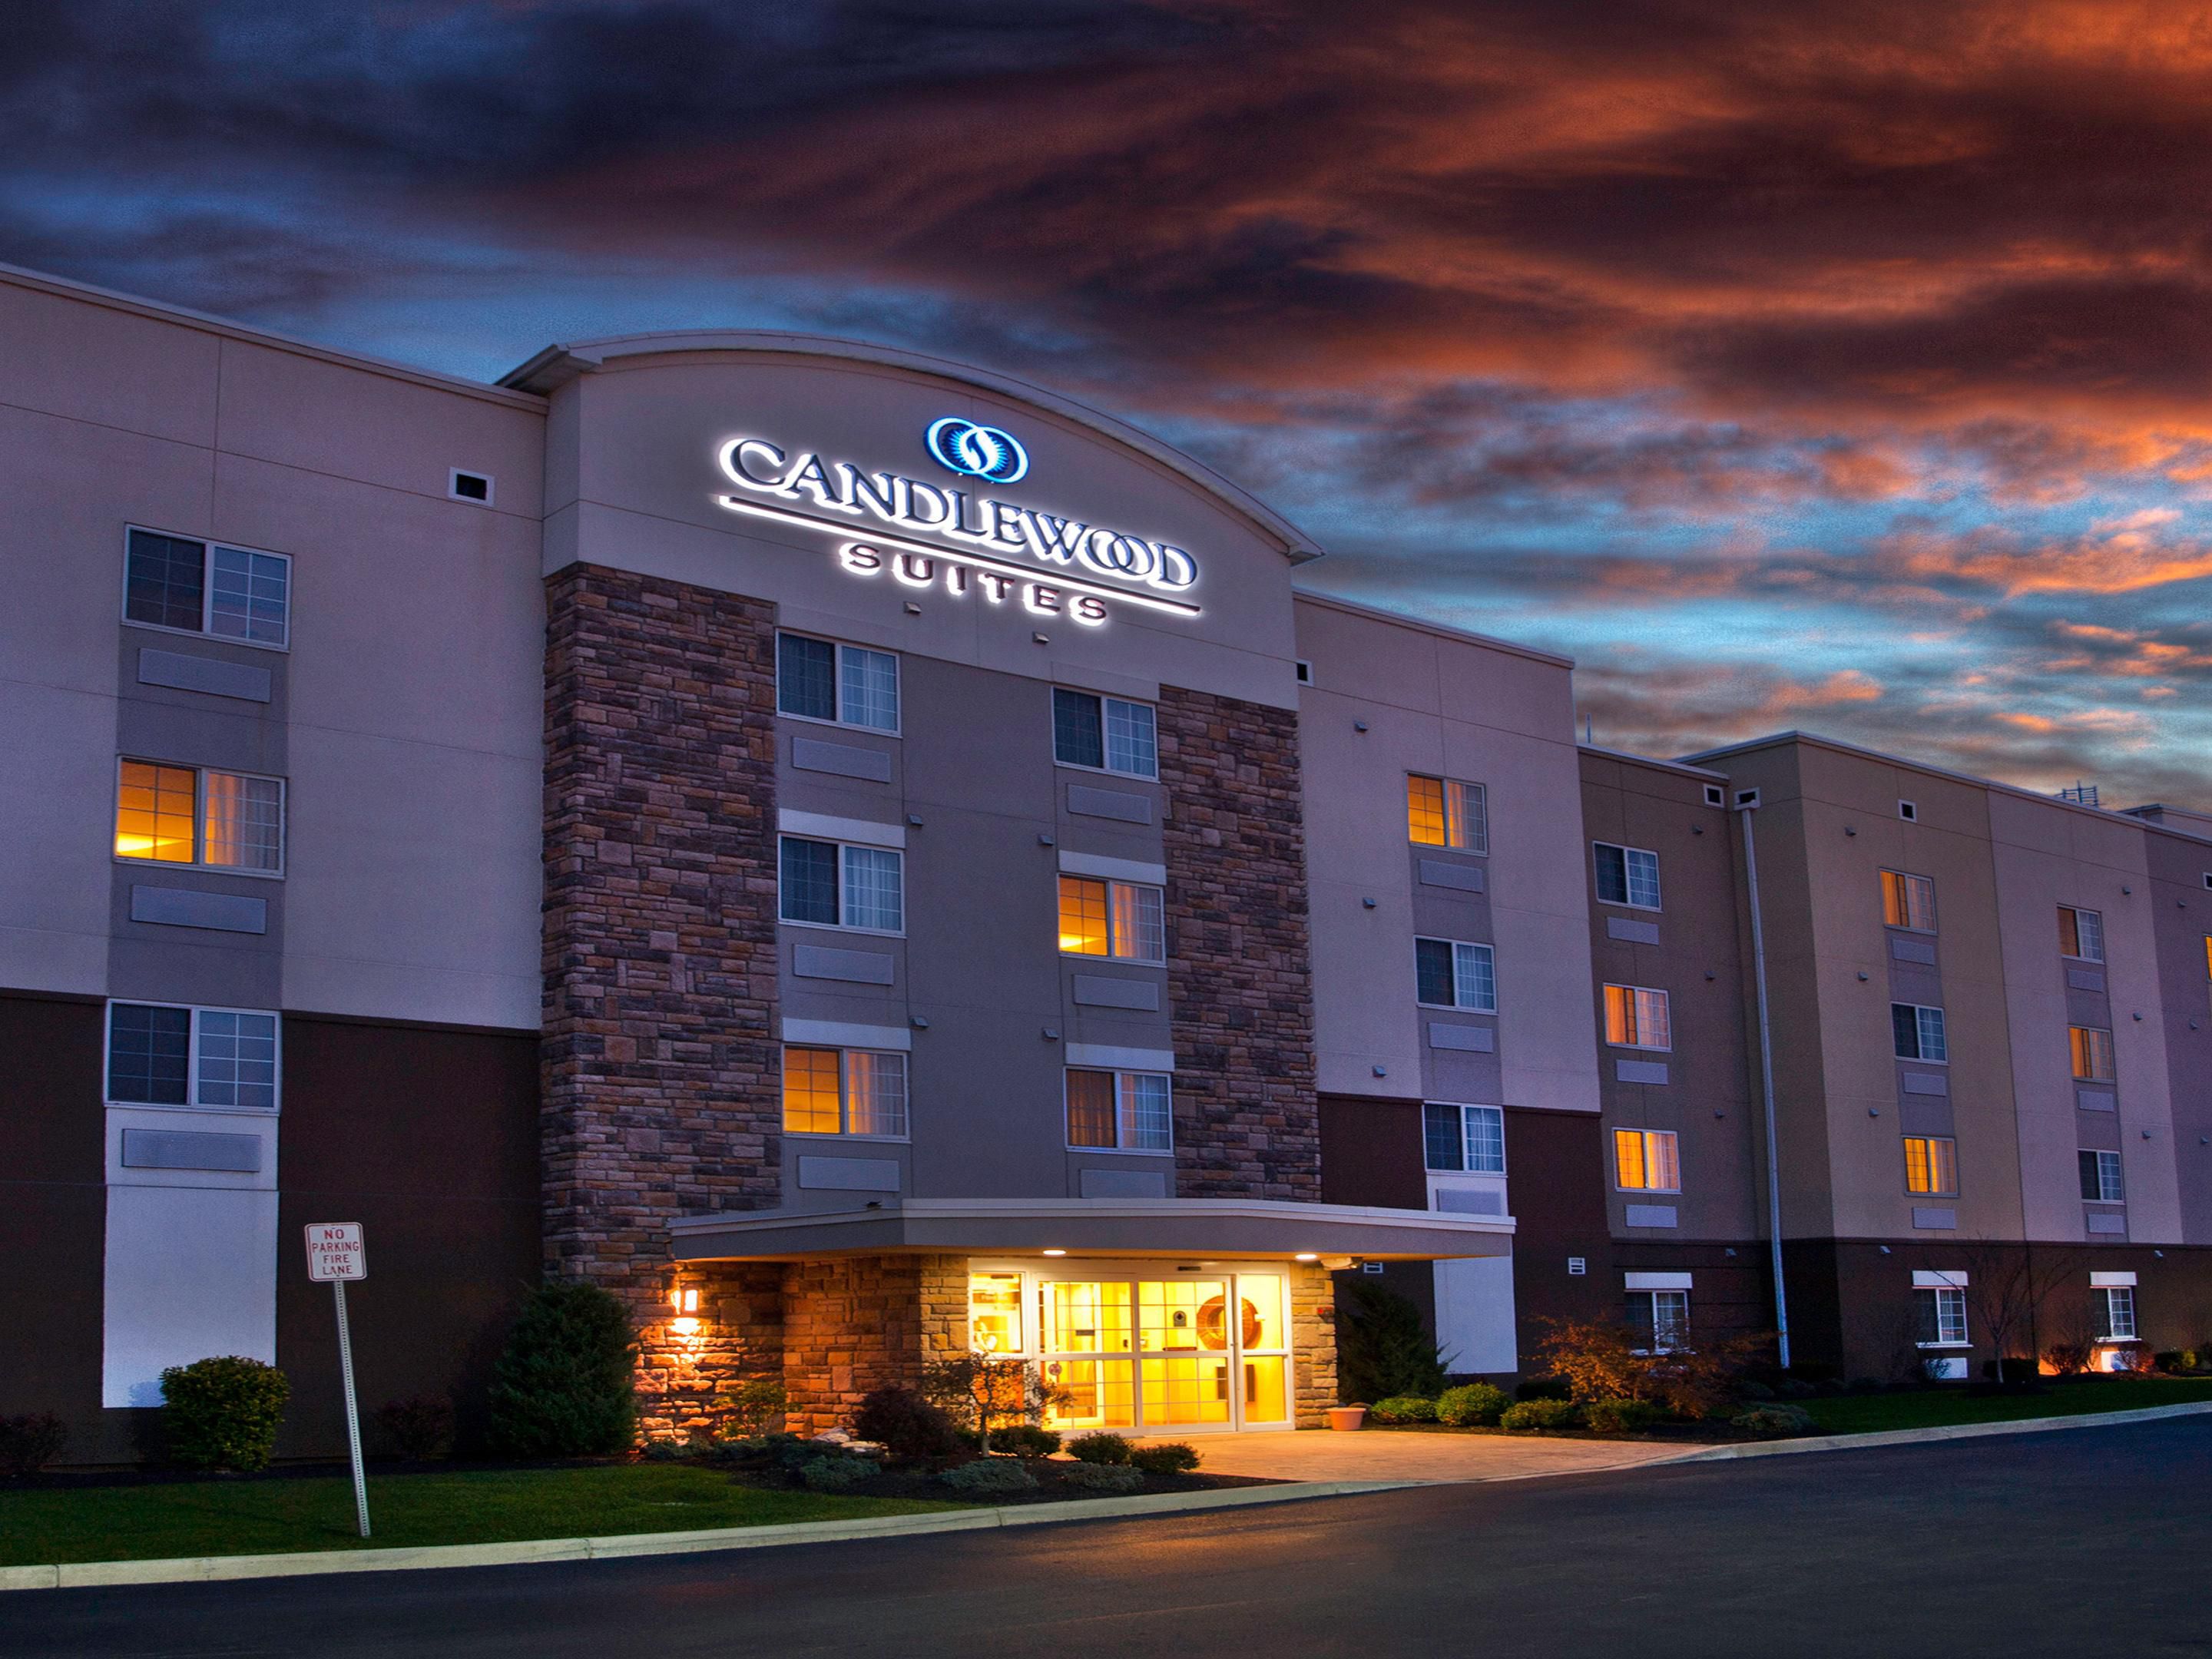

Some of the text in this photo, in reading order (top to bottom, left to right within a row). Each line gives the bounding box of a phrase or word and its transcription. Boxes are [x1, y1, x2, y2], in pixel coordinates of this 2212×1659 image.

[721, 439, 1198, 588] CANDLEWOOD
[844, 543, 1107, 624] SUITES
[324, 1229, 344, 1239] NO
[312, 1241, 359, 1253] PARKING
[323, 1253, 349, 1263] FIRE
[323, 1265, 352, 1275] LANE
